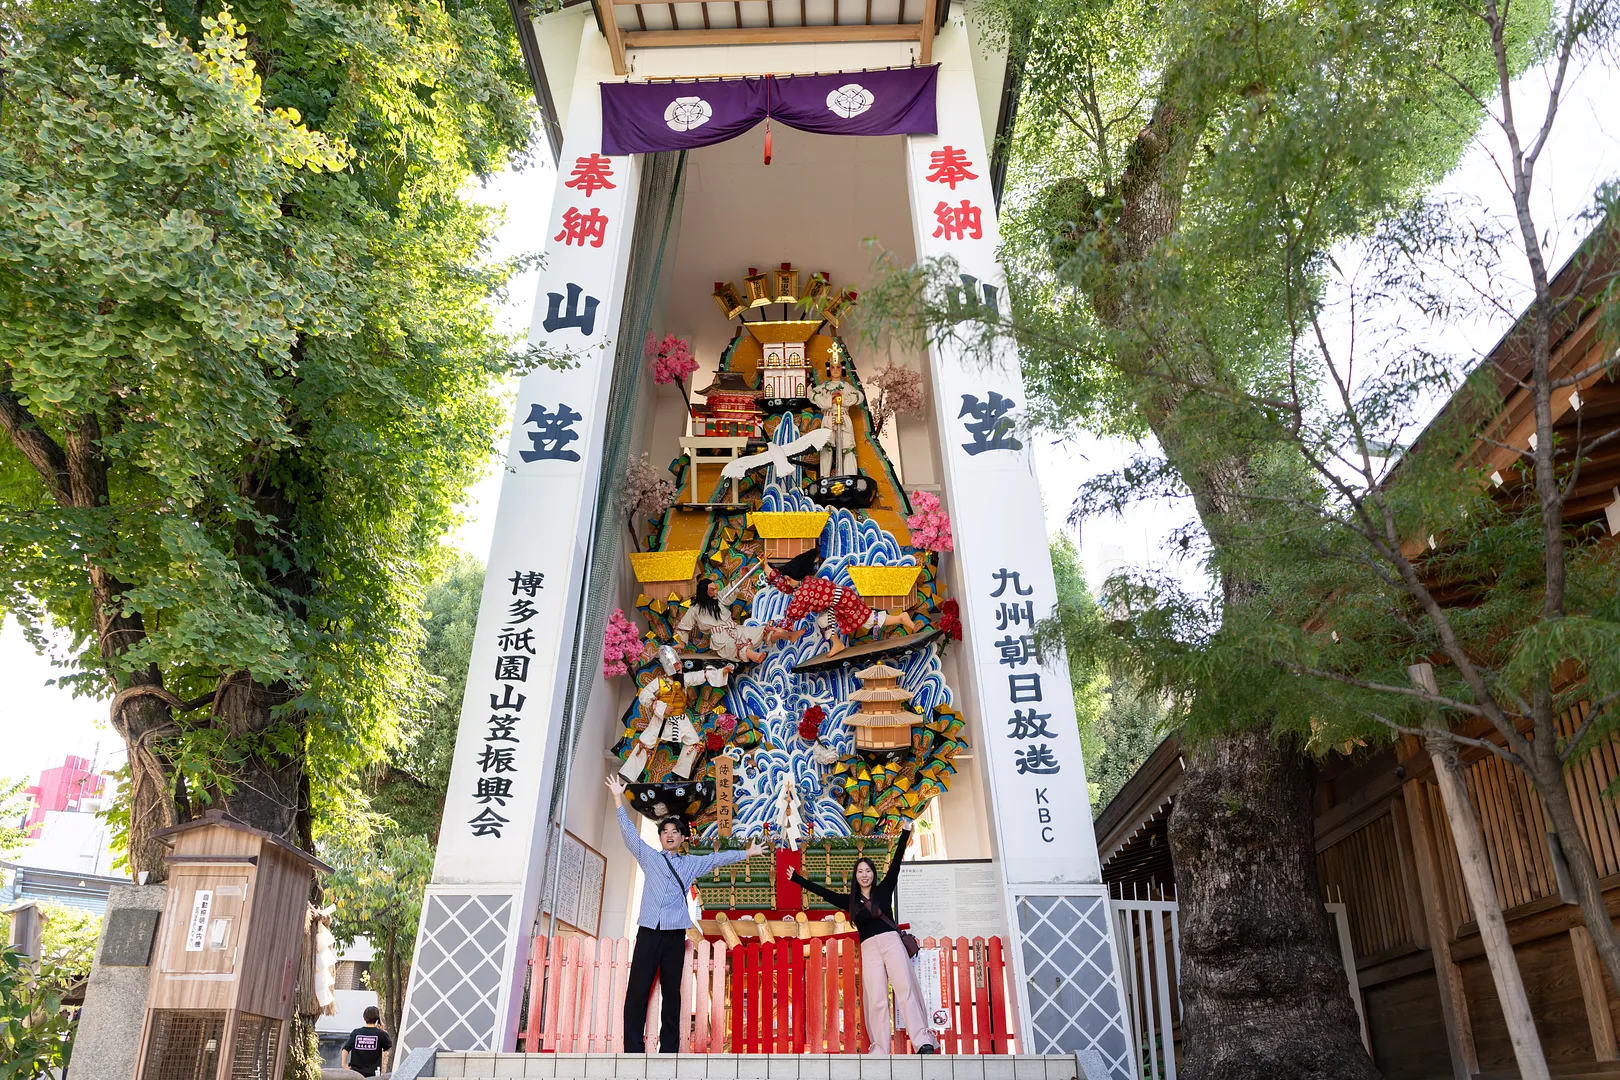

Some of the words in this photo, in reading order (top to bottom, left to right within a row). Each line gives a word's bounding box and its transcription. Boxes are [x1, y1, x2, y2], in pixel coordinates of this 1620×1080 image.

[554, 153, 617, 248] 奉納
[925, 145, 984, 241] 奉納
[519, 282, 601, 463] 山笠
[467, 570, 545, 839] 博多祇園山笠振興会
[989, 567, 1061, 775] 九州朝日放送
[1035, 787, 1054, 843] KBC
